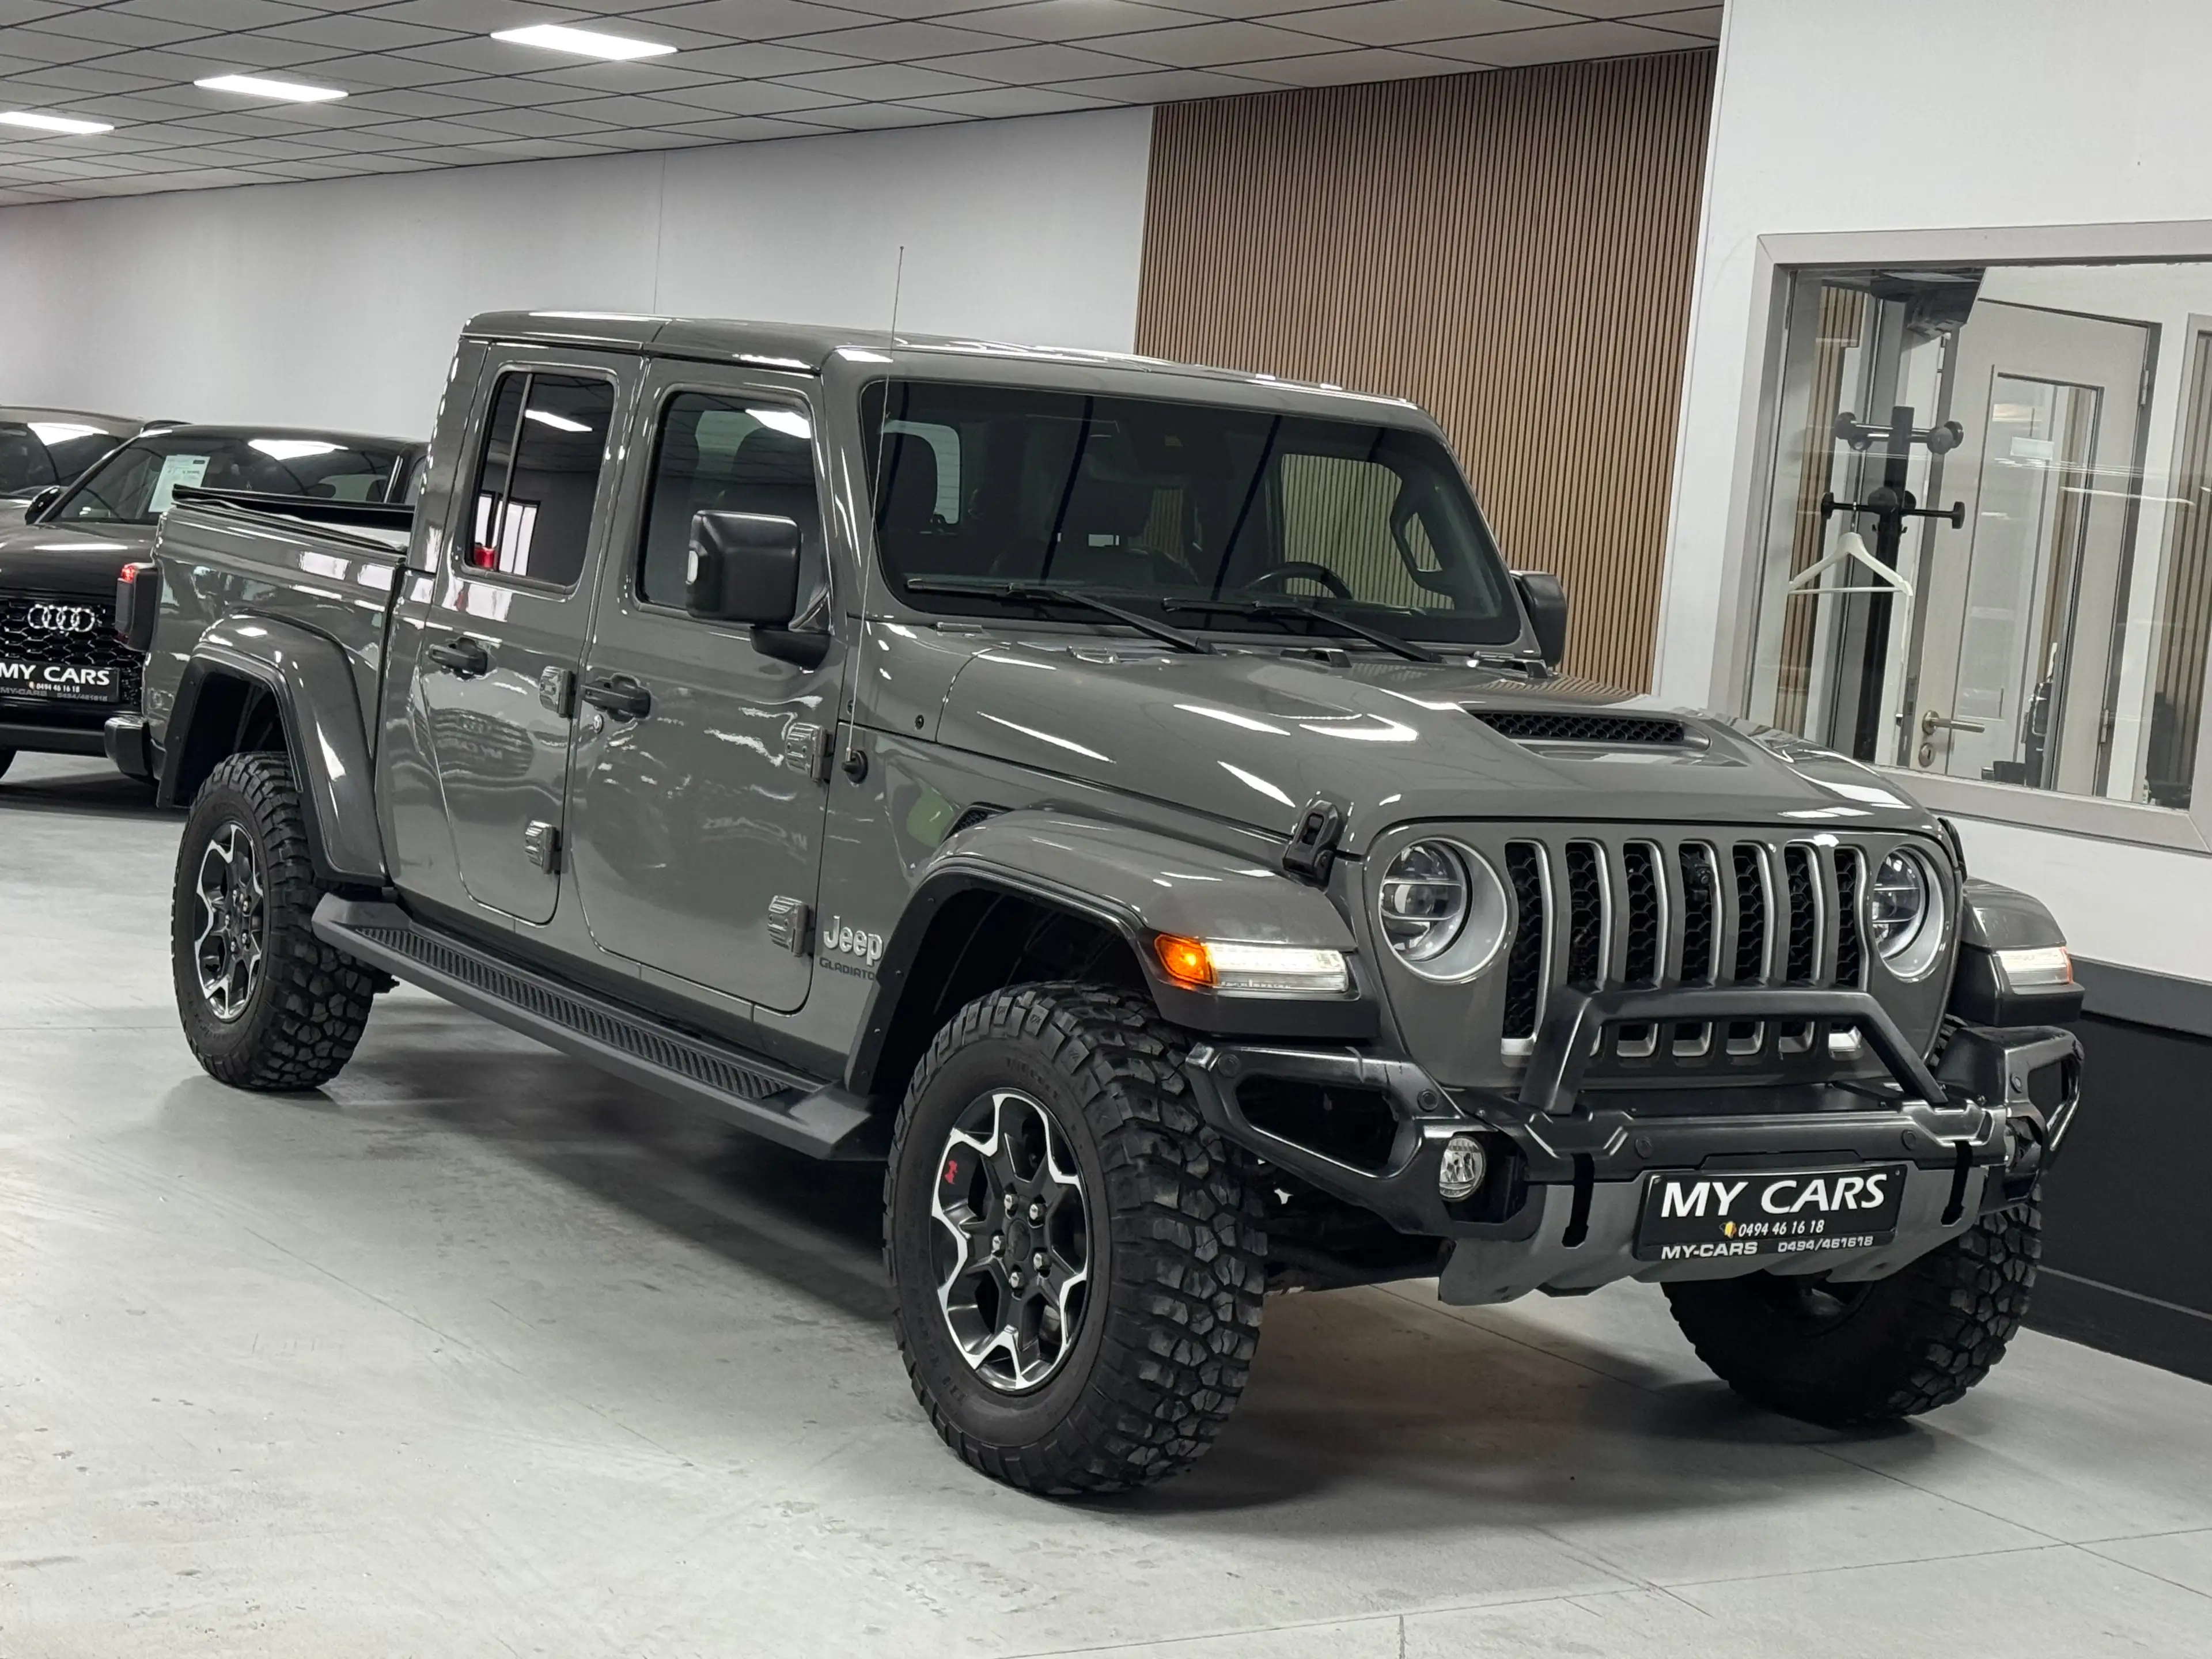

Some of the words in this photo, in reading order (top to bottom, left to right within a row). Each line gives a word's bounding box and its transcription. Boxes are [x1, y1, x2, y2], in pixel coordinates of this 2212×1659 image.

[0, 662, 36, 680] MY
[44, 666, 111, 685] CARS
[823, 915, 883, 967] Jeep
[819, 956, 876, 981] GLADIATO
[1661, 1181, 1749, 1218] MY
[1760, 1173, 1888, 1214] CARS
[1737, 1222, 1769, 1237] 0494
[1772, 1222, 1787, 1236] 46
[1791, 1220, 1806, 1234] 16
[1810, 1219, 1825, 1233] 18
[1661, 1241, 1758, 1260] MY-CARS
[1778, 1236, 1874, 1253] 0494/461618
